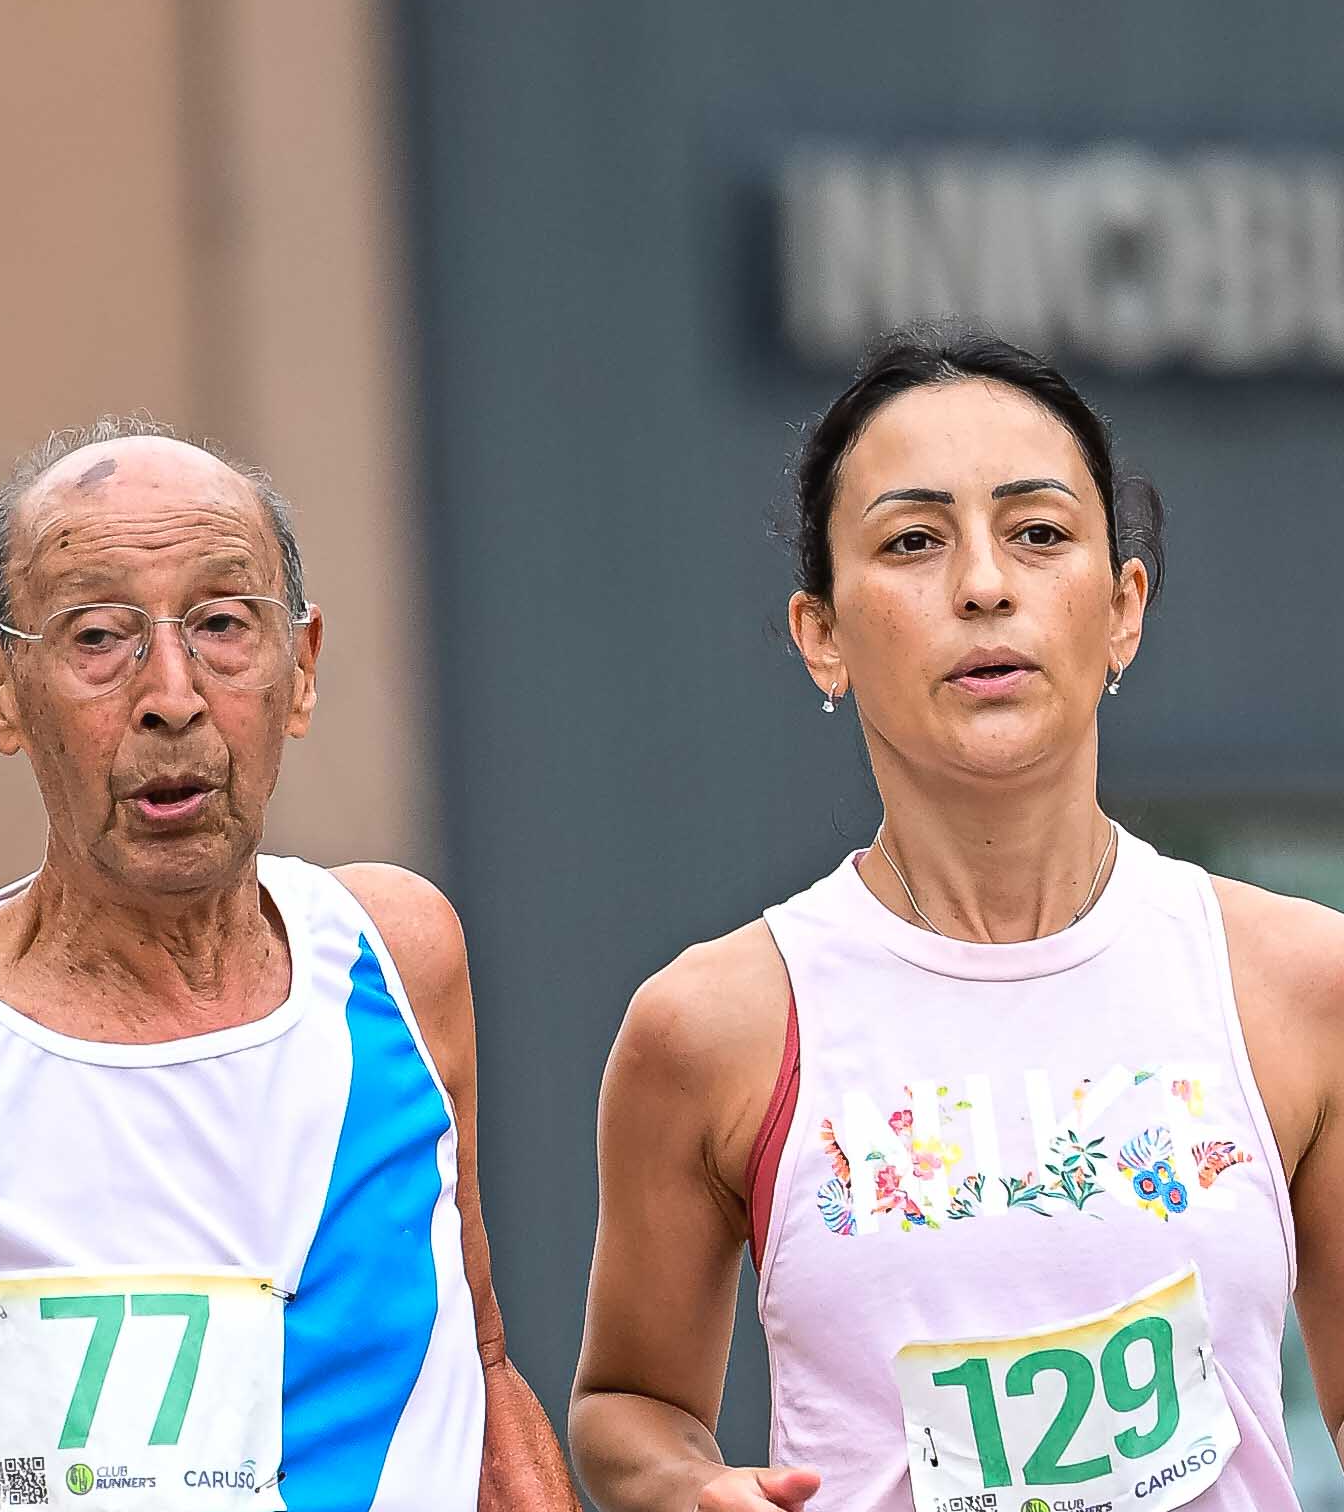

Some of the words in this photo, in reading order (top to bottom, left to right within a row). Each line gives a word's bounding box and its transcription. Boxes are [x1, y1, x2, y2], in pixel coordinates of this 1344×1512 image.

[40, 1294, 210, 1449] 77
[932, 1316, 1180, 1489] 129
[96, 1465, 128, 1478] CLUB
[184, 1469, 255, 1489] CARUSO
[1134, 1448, 1218, 1499] CARUSO
[96, 1476, 156, 1489] RUNNER'S
[1053, 1498, 1084, 1512] CLUB
